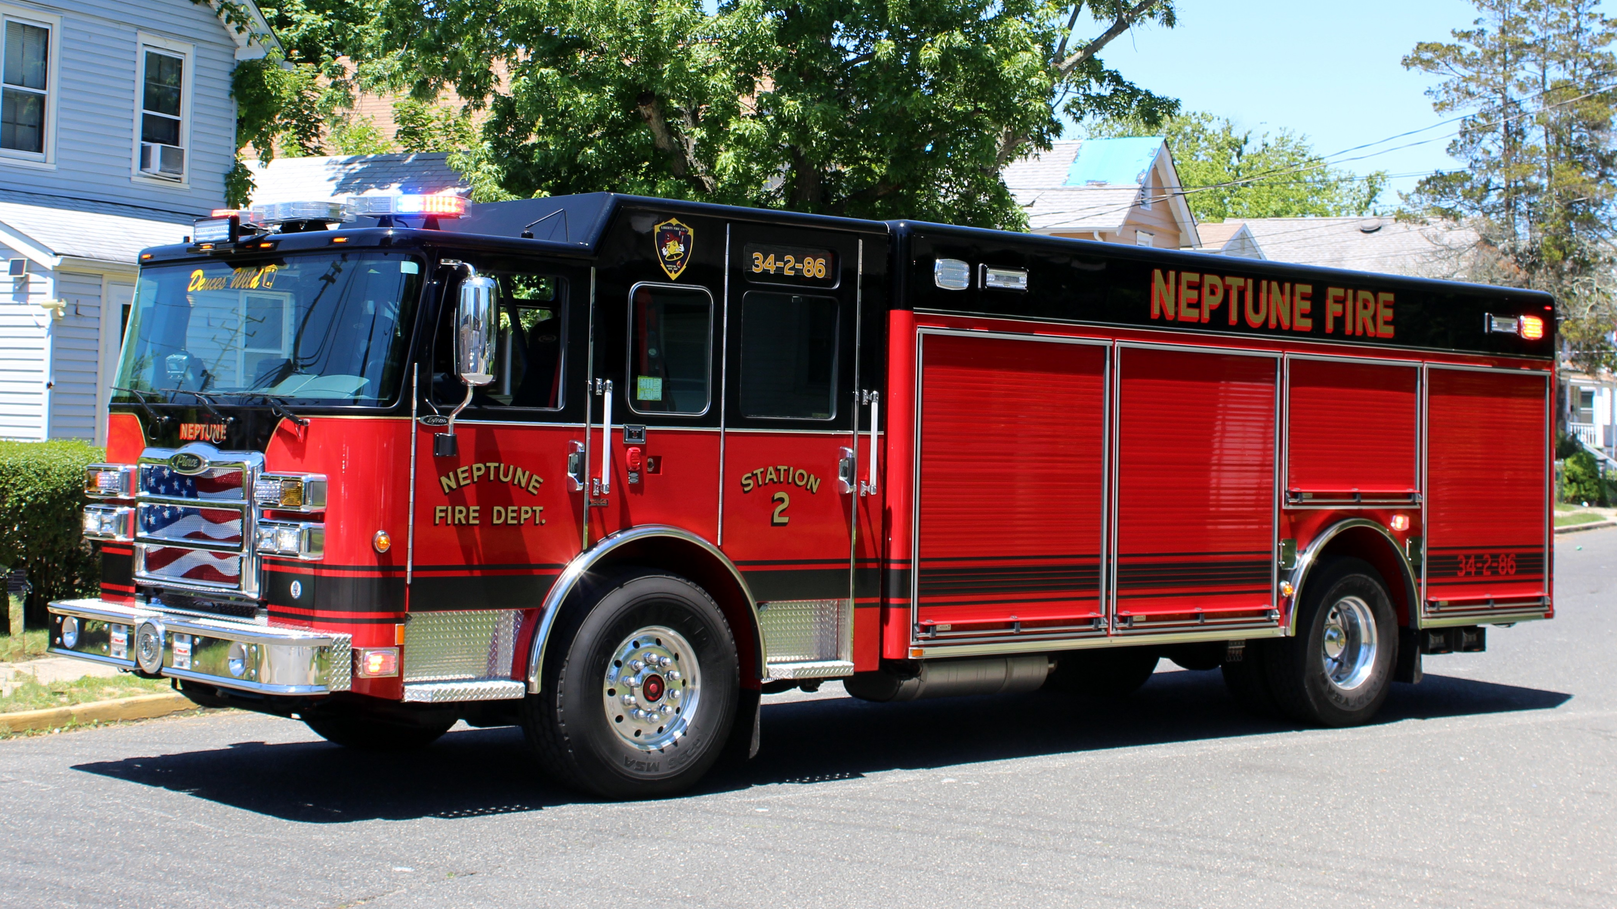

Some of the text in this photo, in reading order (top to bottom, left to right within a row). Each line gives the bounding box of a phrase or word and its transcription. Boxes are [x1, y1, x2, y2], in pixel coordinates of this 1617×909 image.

[752, 252, 826, 279] 34-2-86
[187, 267, 264, 292] Deuces Wild
[1150, 268, 1395, 339] NEPTUNE FIRE
[179, 423, 227, 441] NEPTUNE
[439, 462, 544, 496] NEPTUNE
[740, 465, 821, 494] STATION
[434, 506, 547, 526] FIRE DEPT.
[771, 491, 790, 527] 2
[1457, 553, 1517, 577] 34-2-86
[623, 754, 660, 773] MSA
